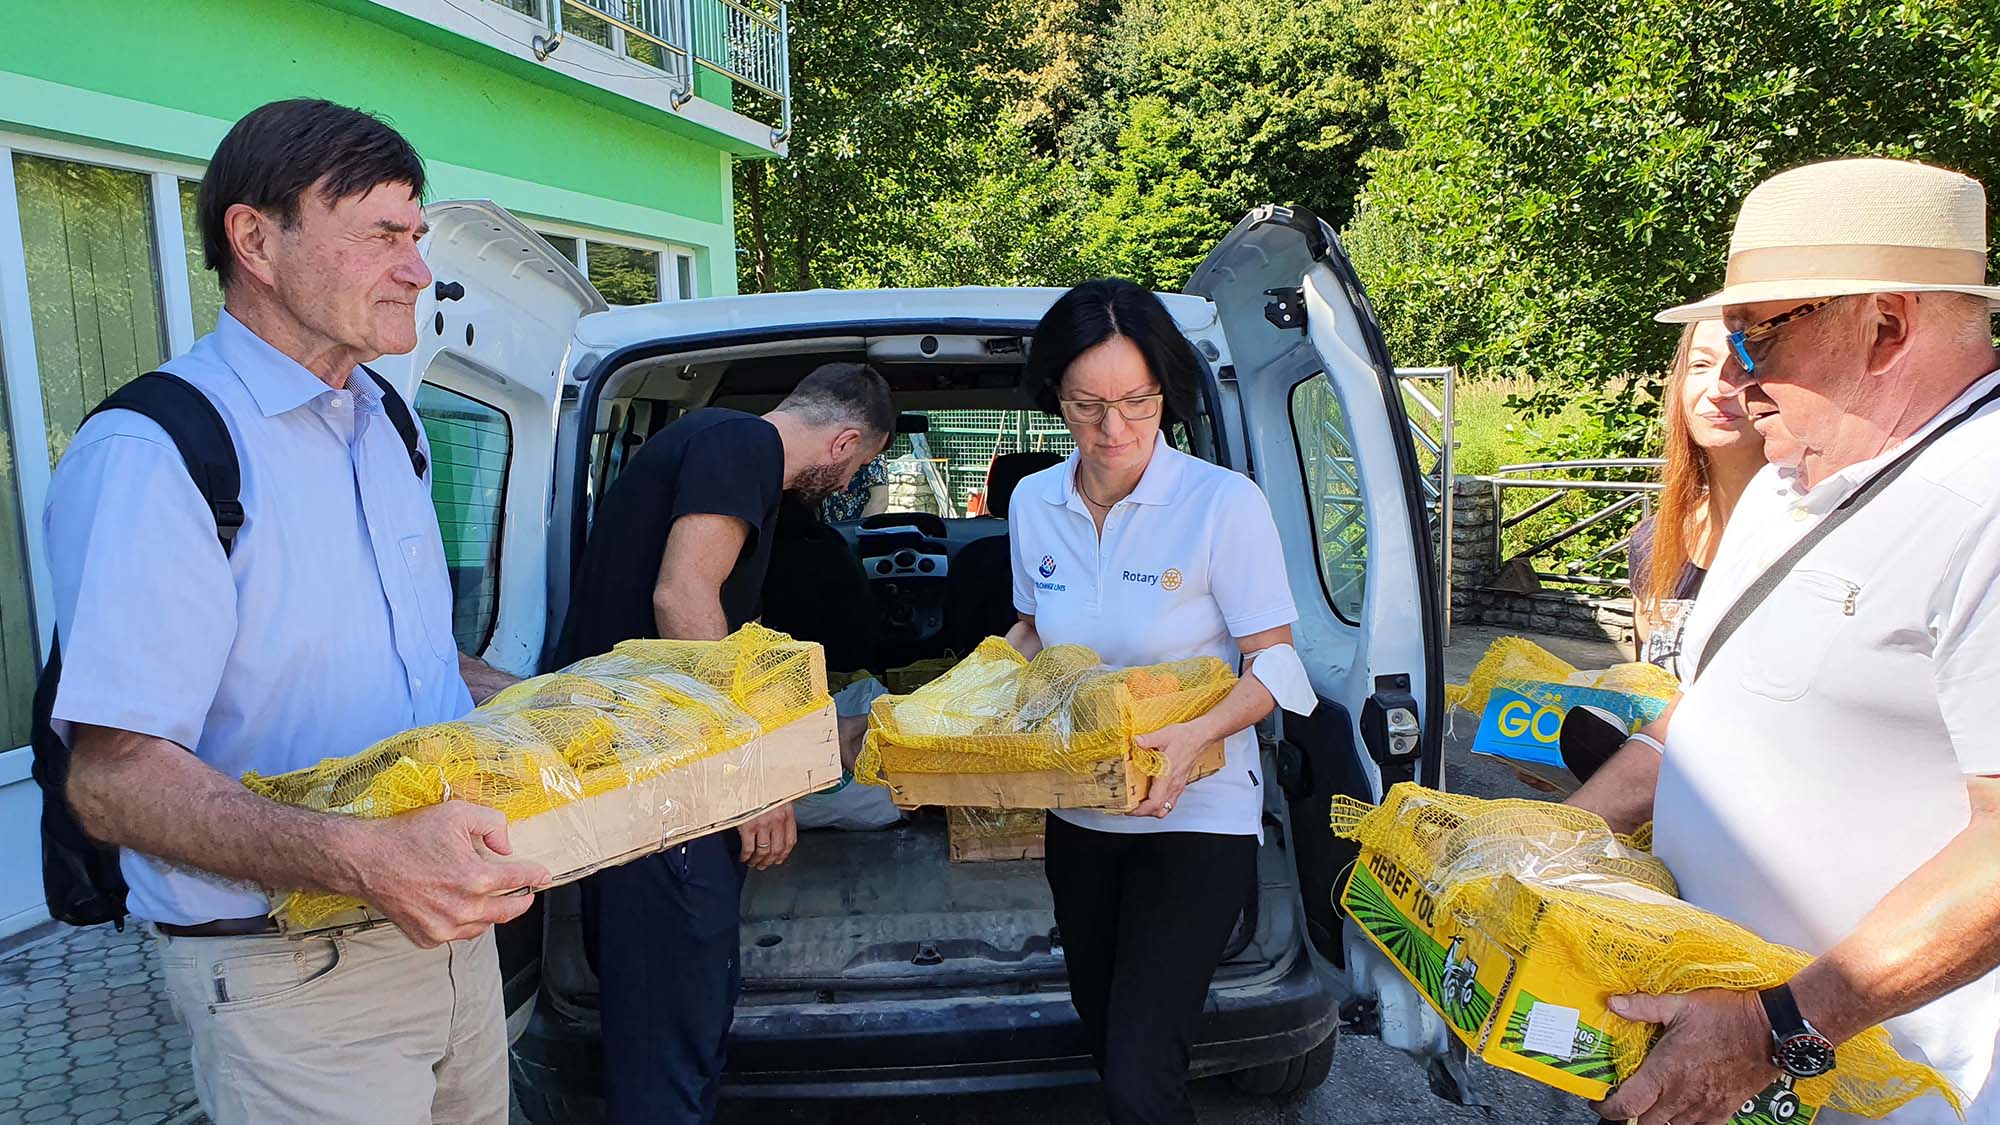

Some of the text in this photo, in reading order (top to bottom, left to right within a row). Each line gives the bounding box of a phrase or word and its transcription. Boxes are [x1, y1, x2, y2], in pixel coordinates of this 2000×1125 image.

[1122, 570, 1159, 586] Rotary
[1368, 853, 1413, 900] HEDEF
[1574, 1028, 1596, 1044] 106
